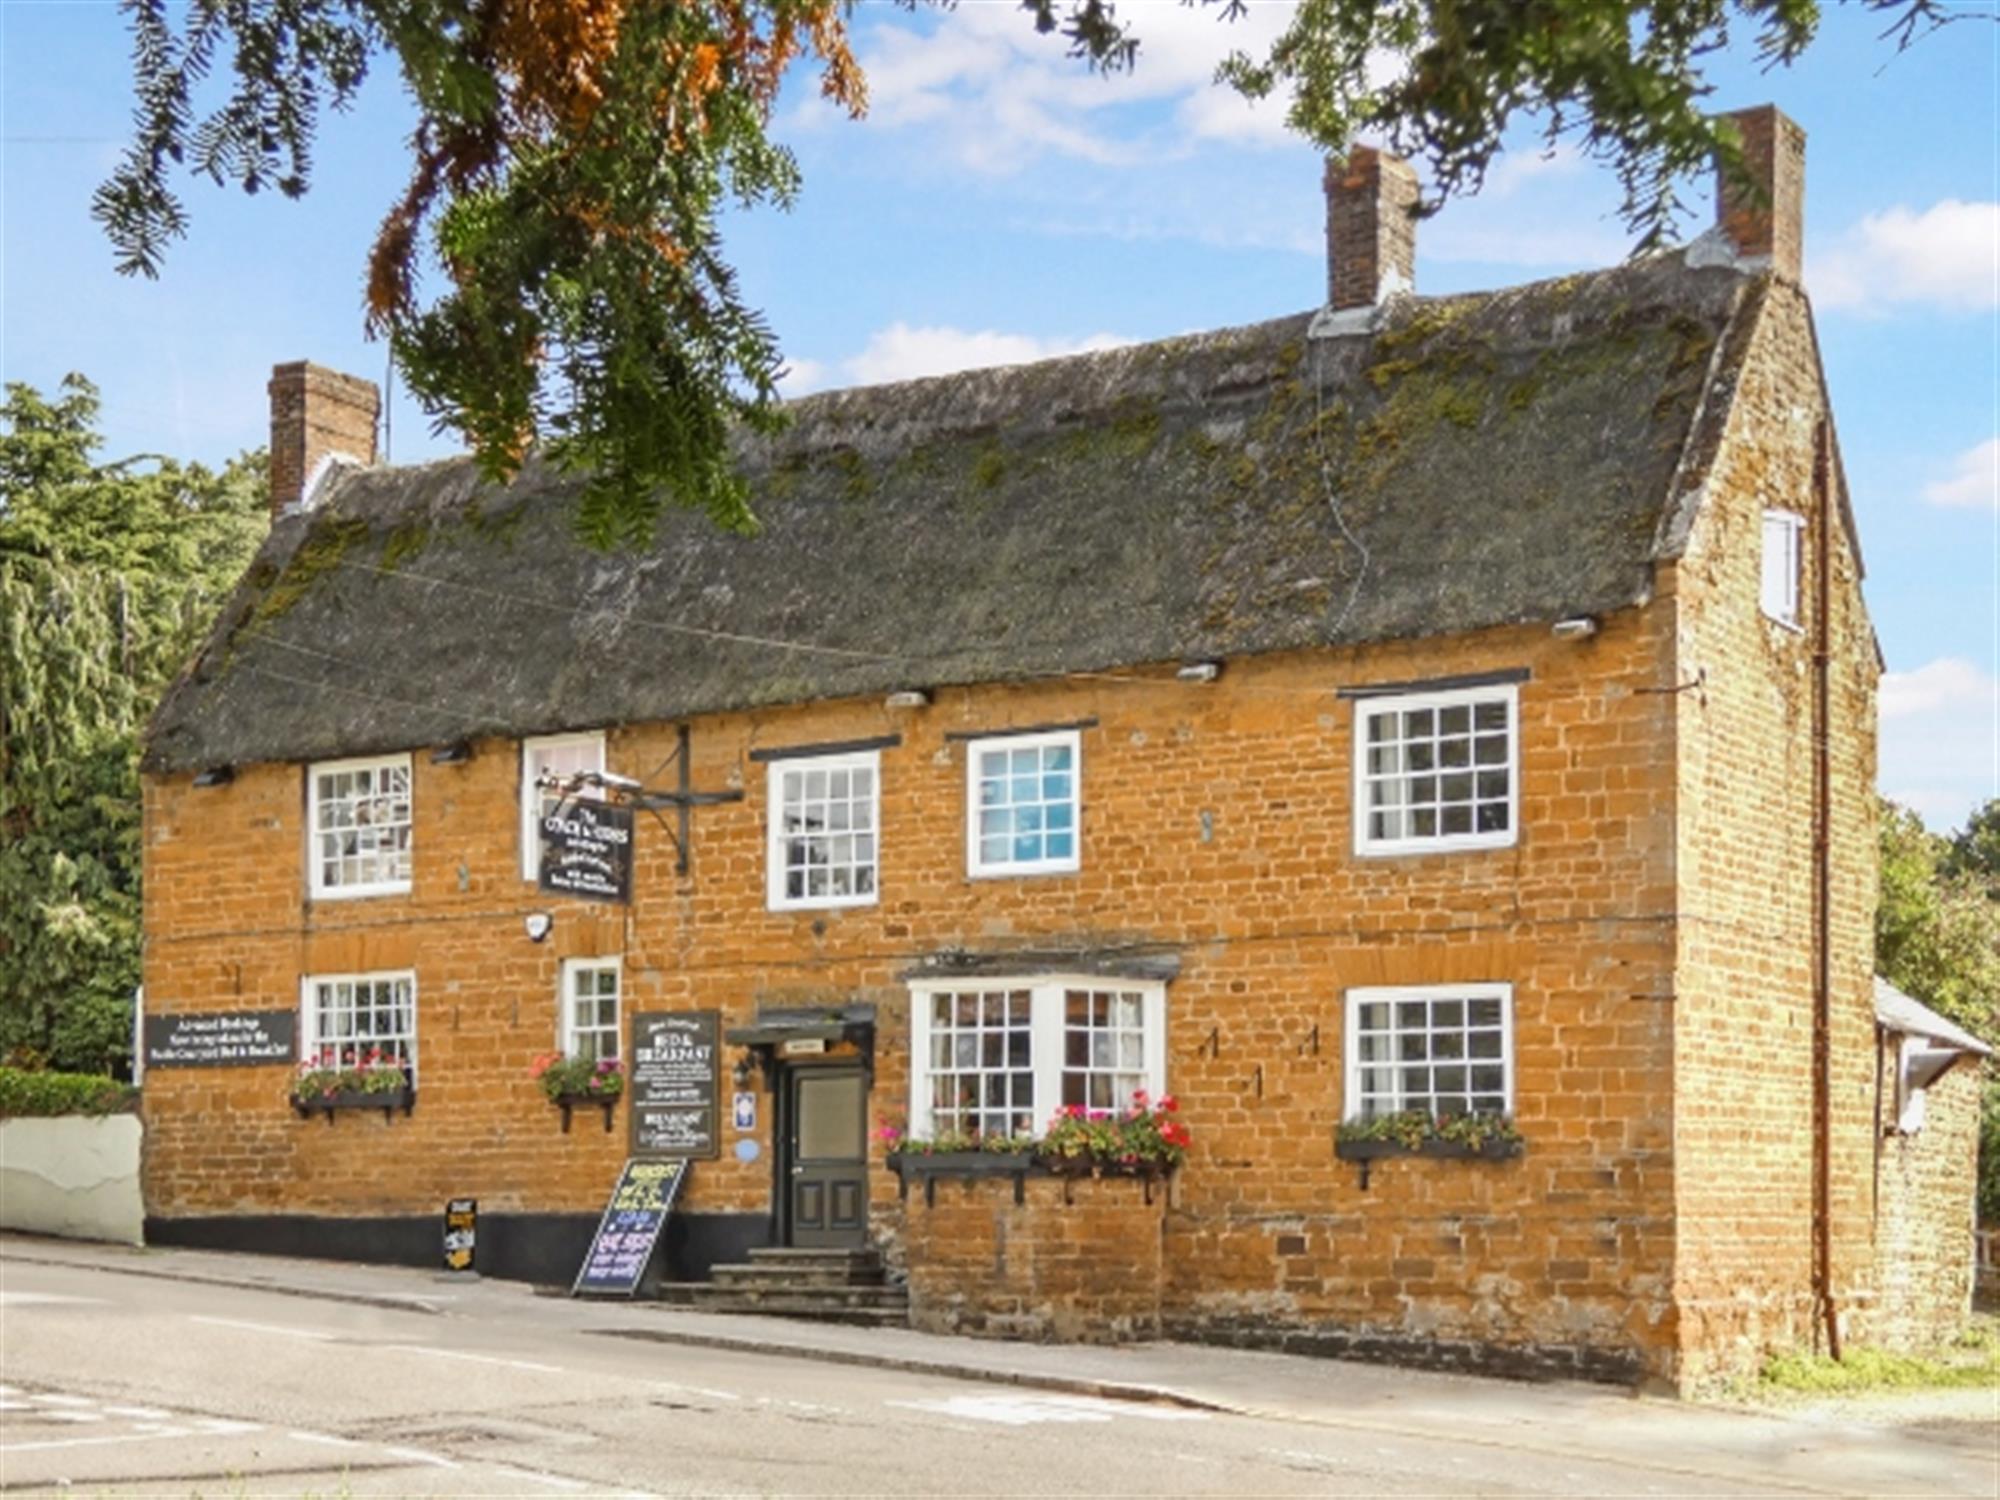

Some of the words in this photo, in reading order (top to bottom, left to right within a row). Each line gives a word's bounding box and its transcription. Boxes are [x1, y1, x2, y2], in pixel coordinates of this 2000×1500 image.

[654, 1033, 681, 1047] BED
[220, 1045, 238, 1058] Bed
[636, 1044, 712, 1063] BREAKFAST
